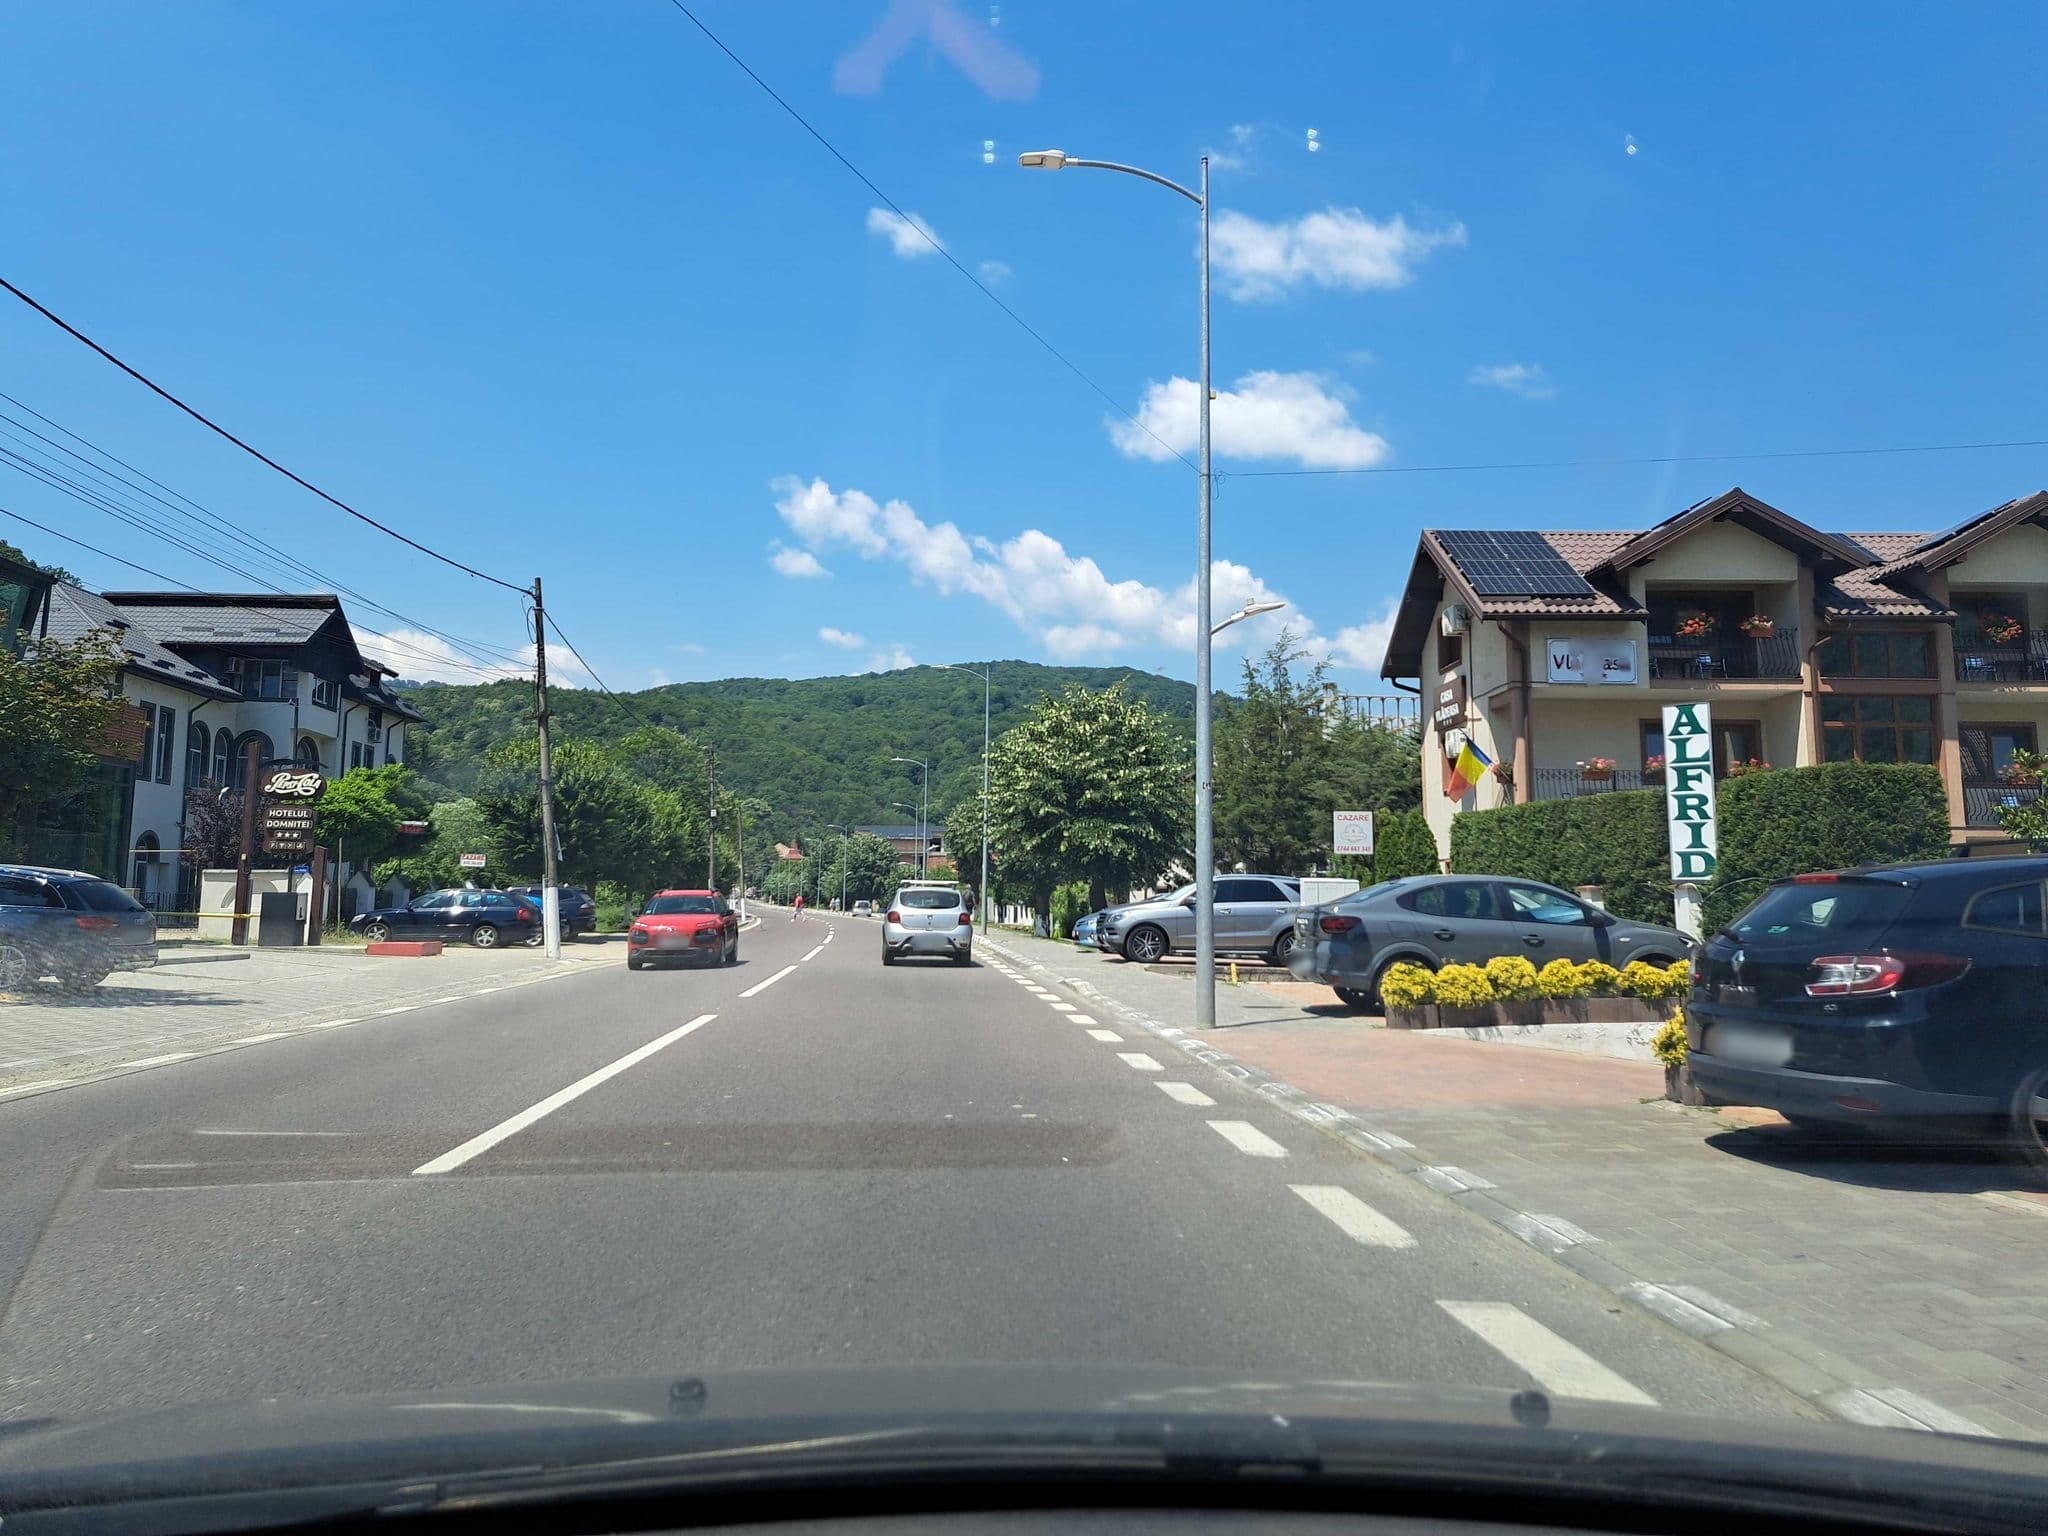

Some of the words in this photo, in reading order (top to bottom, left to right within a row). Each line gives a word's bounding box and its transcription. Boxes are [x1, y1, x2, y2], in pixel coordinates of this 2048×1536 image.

[1667, 703, 1717, 878] ALFRID
[269, 809, 308, 818] HOTELUL
[266, 820, 310, 829] DOMNITEI
